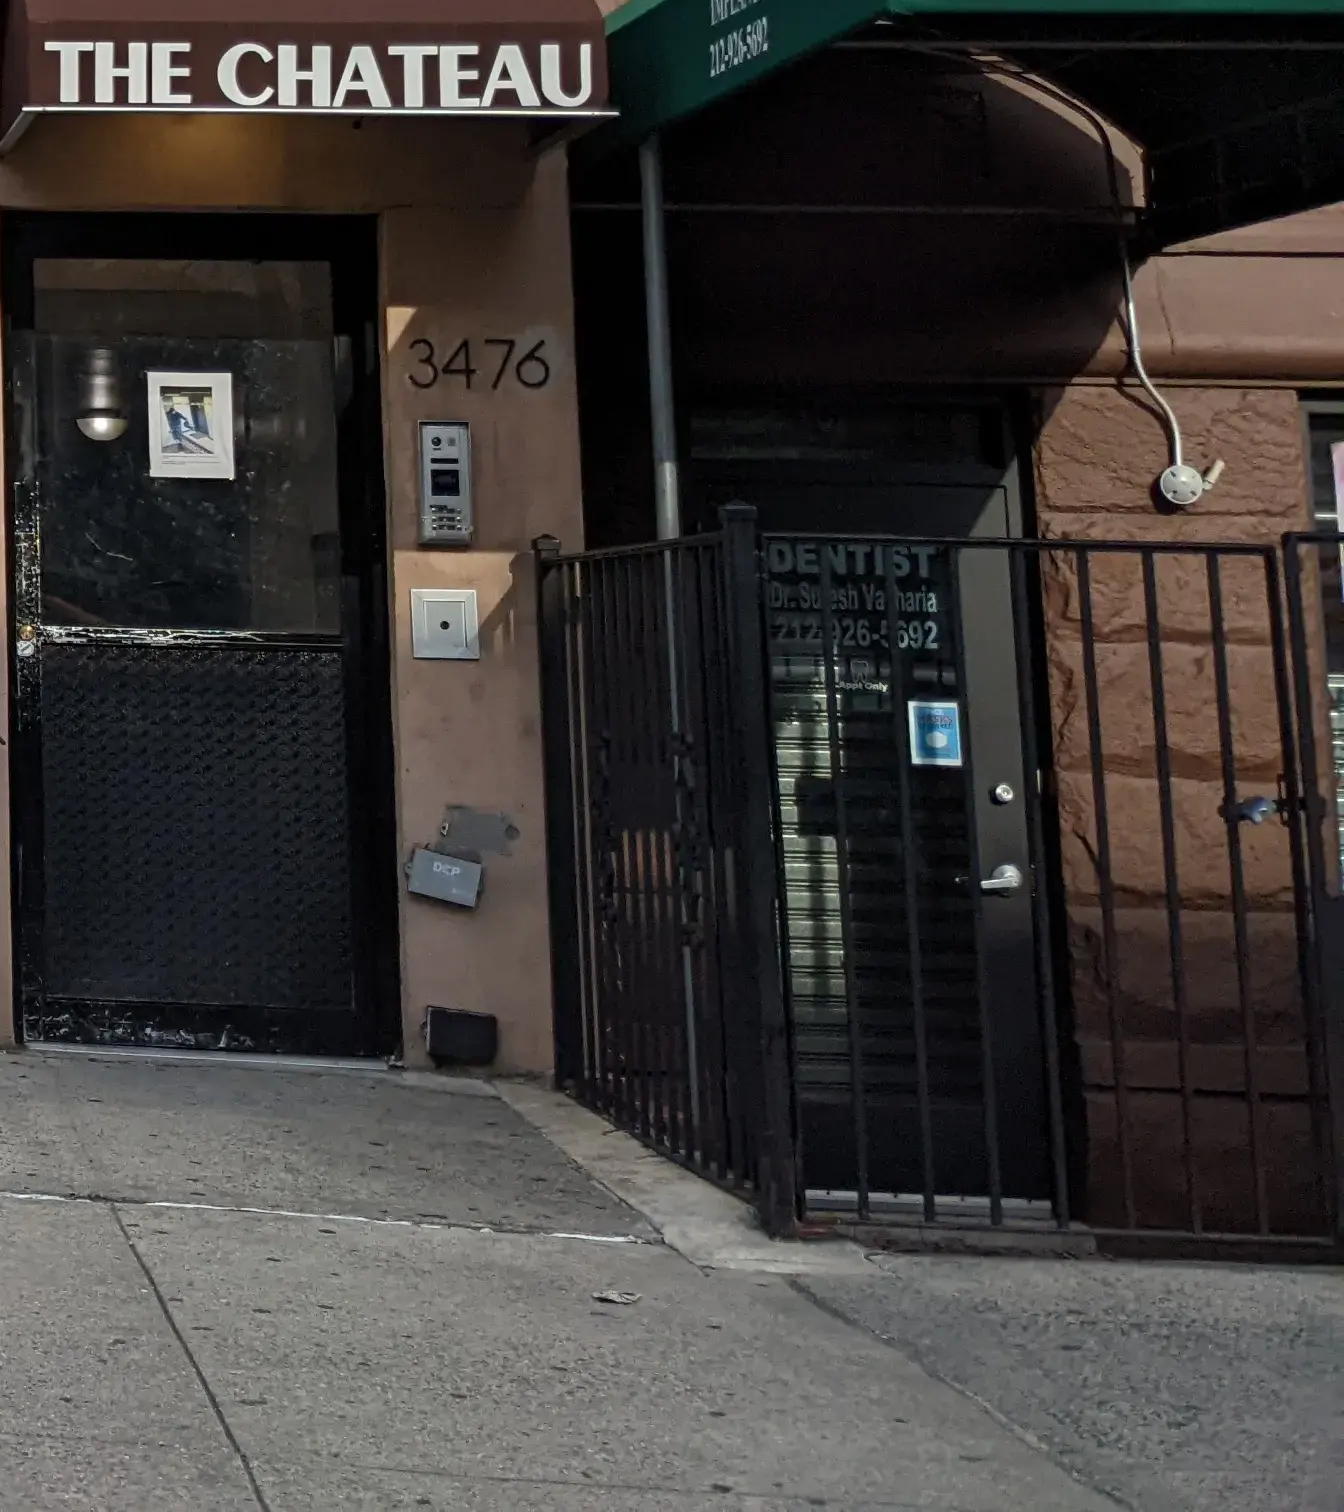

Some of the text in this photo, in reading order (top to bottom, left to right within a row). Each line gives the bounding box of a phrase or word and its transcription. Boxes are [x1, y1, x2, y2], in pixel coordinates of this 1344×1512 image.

[44, 41, 592, 108] THE CHATEAU
[709, 16, 769, 78] 212-926-5692
[407, 338, 551, 390] 3476
[768, 541, 939, 578] DENTIST
